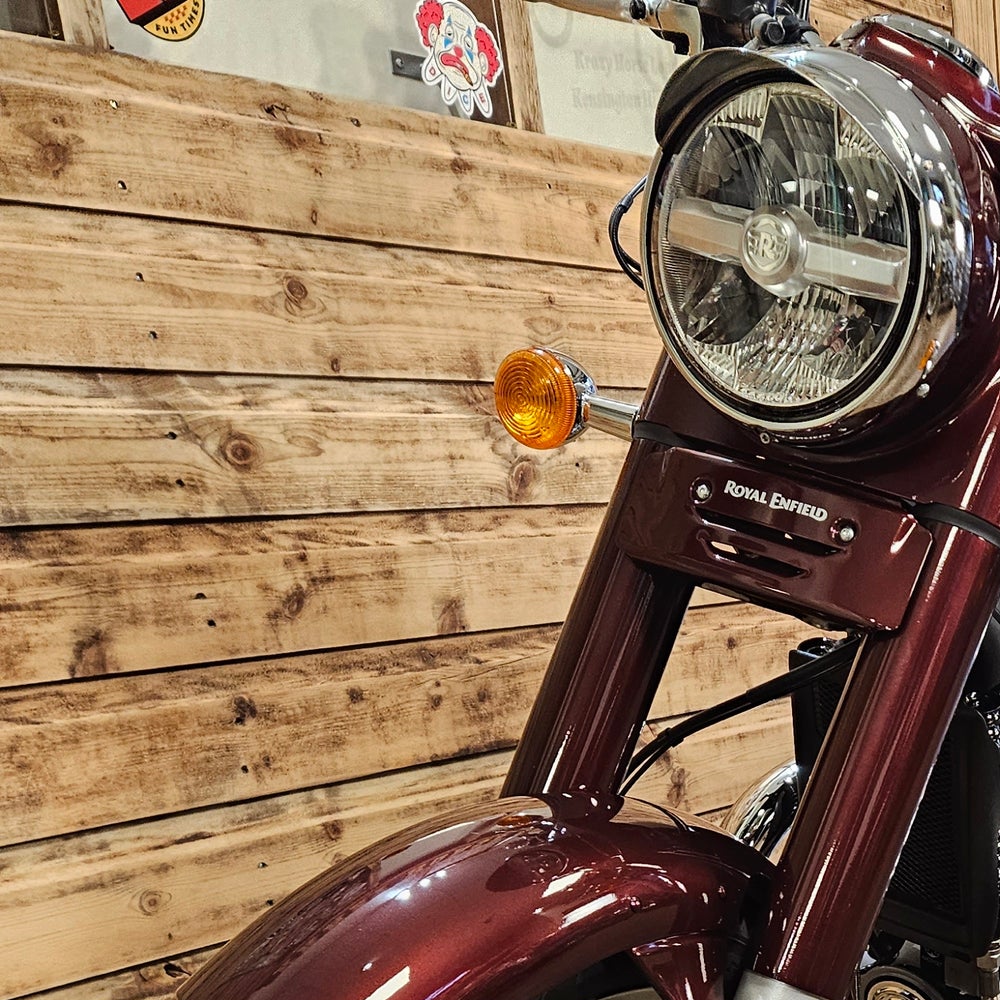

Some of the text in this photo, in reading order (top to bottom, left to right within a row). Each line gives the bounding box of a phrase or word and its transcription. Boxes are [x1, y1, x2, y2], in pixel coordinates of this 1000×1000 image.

[155, 0, 200, 35] FUN TIMES
[723, 479, 828, 522] ROYAL ENFIELD
